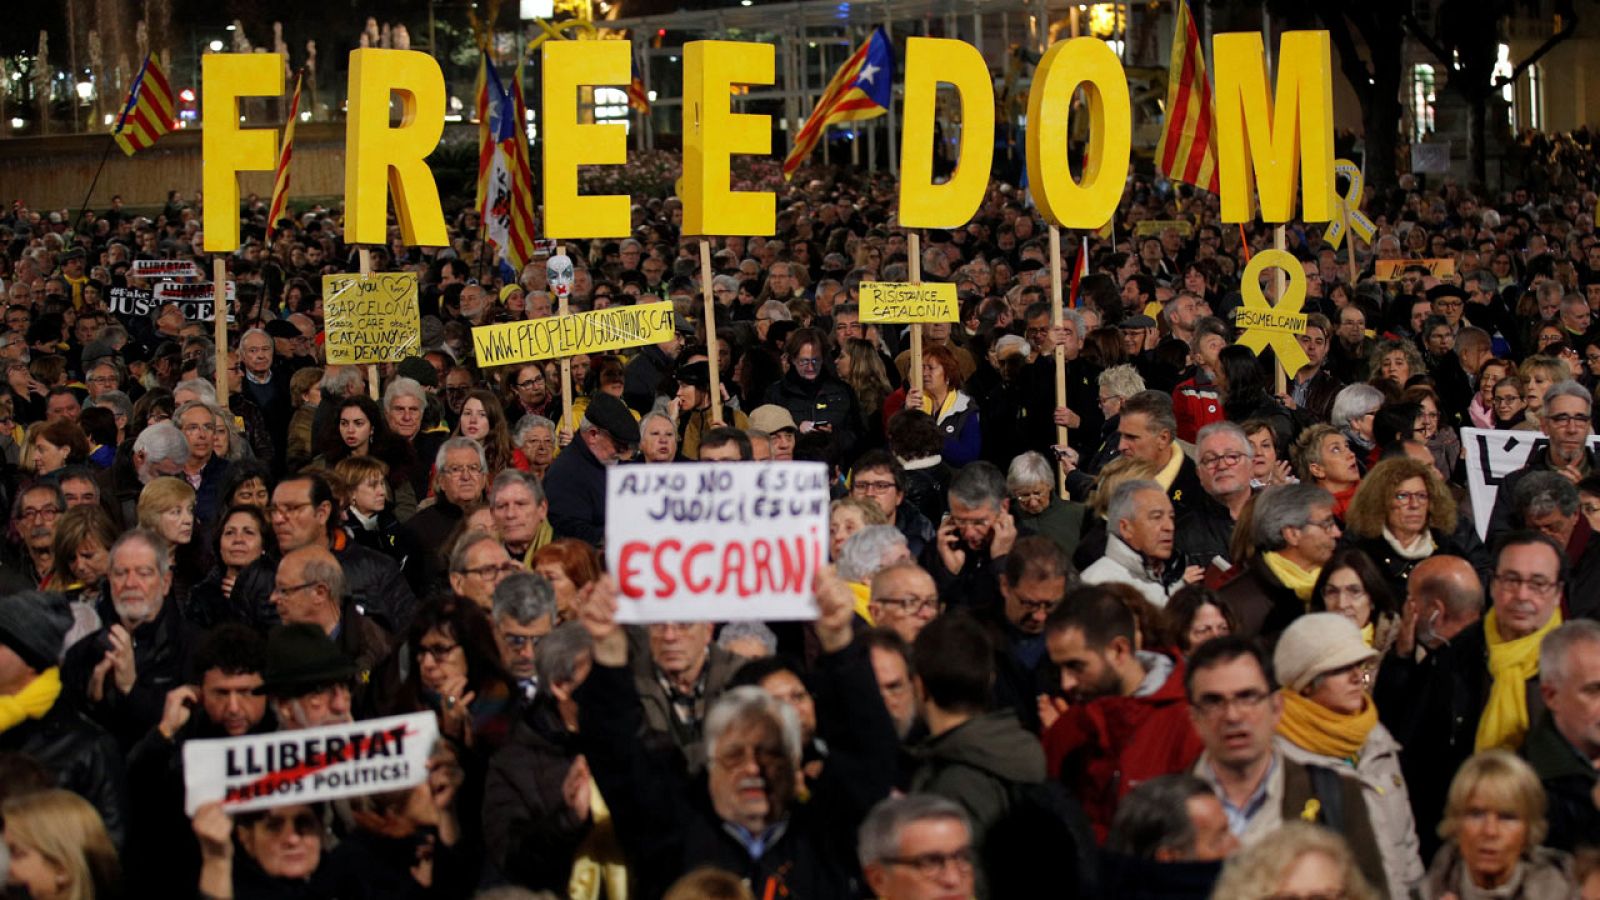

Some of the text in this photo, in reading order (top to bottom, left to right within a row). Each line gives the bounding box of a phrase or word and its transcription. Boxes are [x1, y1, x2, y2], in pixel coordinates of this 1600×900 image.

[202, 30, 1334, 252] FREEDOM
[872, 304, 950, 319] CATALONIA
[699, 470, 732, 494] NO
[226, 724, 407, 777] LLIBERTAT
